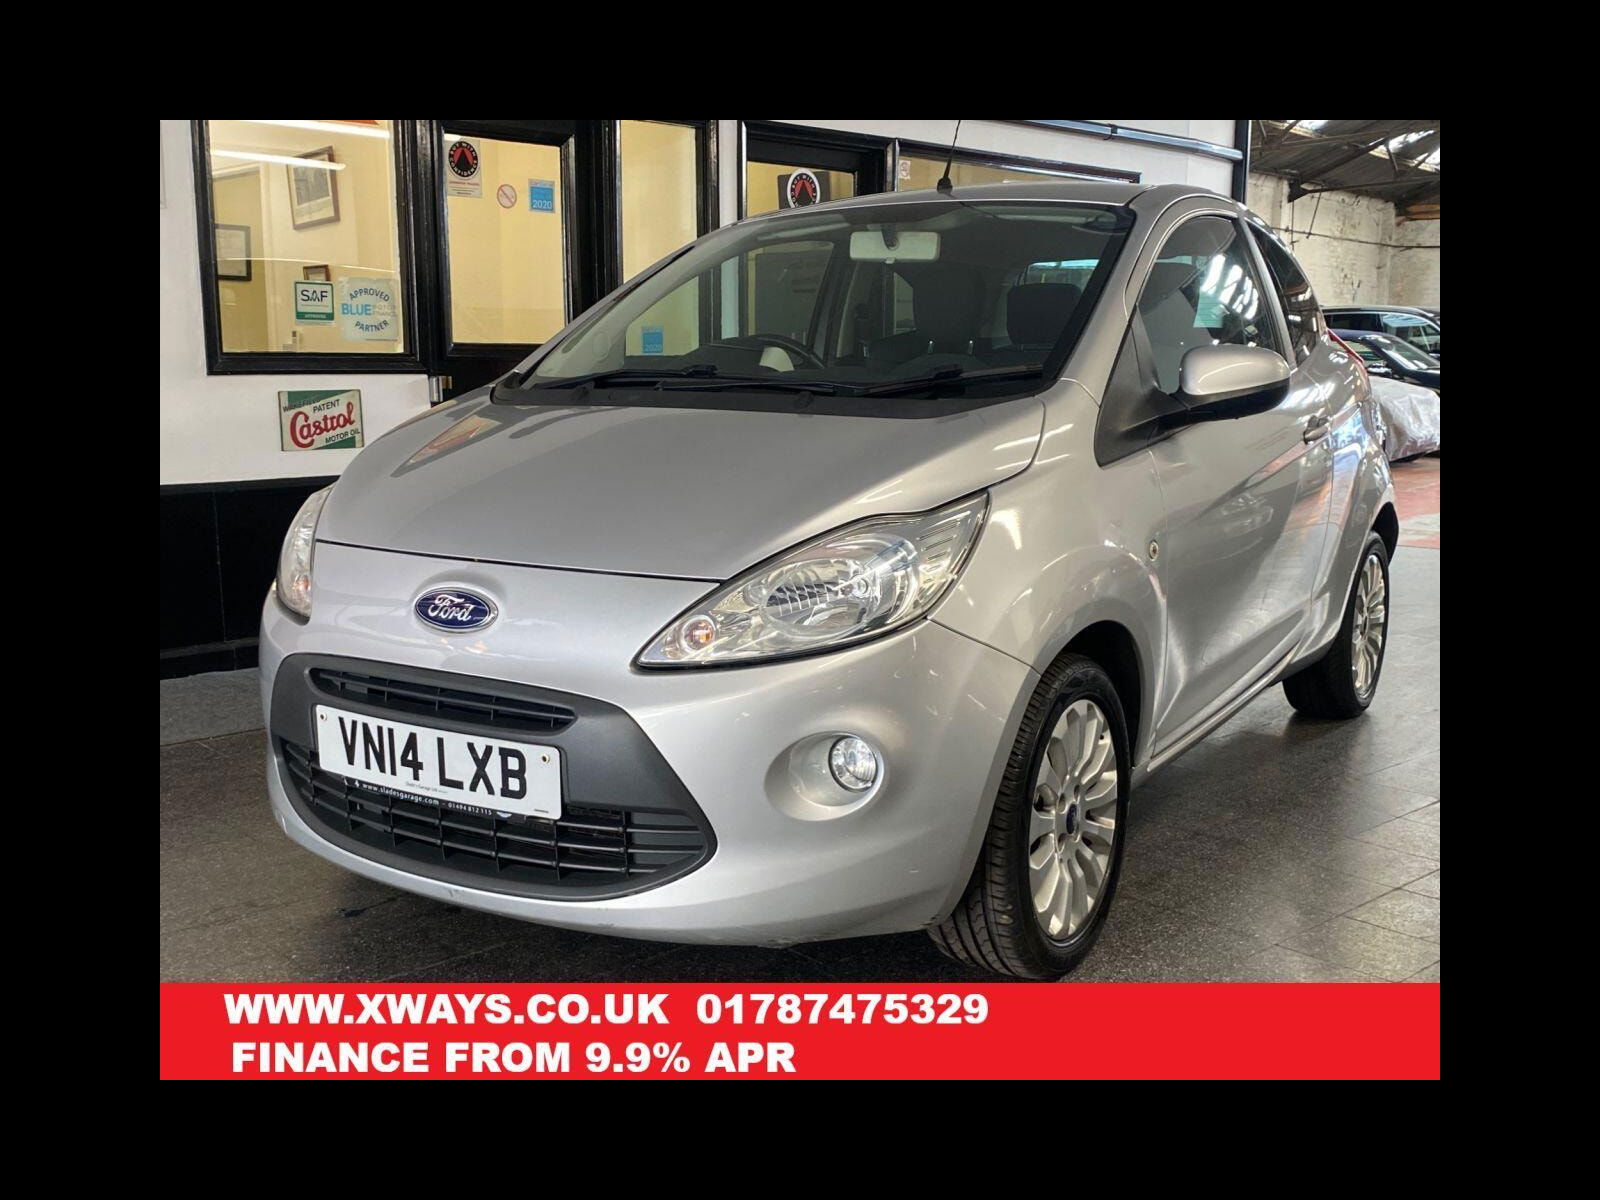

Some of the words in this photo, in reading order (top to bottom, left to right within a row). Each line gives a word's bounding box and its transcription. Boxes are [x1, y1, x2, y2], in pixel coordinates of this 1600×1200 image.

[532, 199, 553, 210] 2020
[300, 289, 329, 302] SAF
[349, 287, 390, 302] APPROVED
[341, 303, 372, 316] BLUE
[354, 319, 390, 332] PARTNER
[313, 398, 340, 413] PATENT
[289, 401, 356, 449] Castrol
[325, 431, 349, 444] MOTOR
[350, 428, 361, 436] OIL
[427, 593, 476, 621] Ford
[338, 716, 424, 781] VN14
[437, 736, 527, 800] LXB
[362, 783, 440, 805] www.sladesgarage.com
